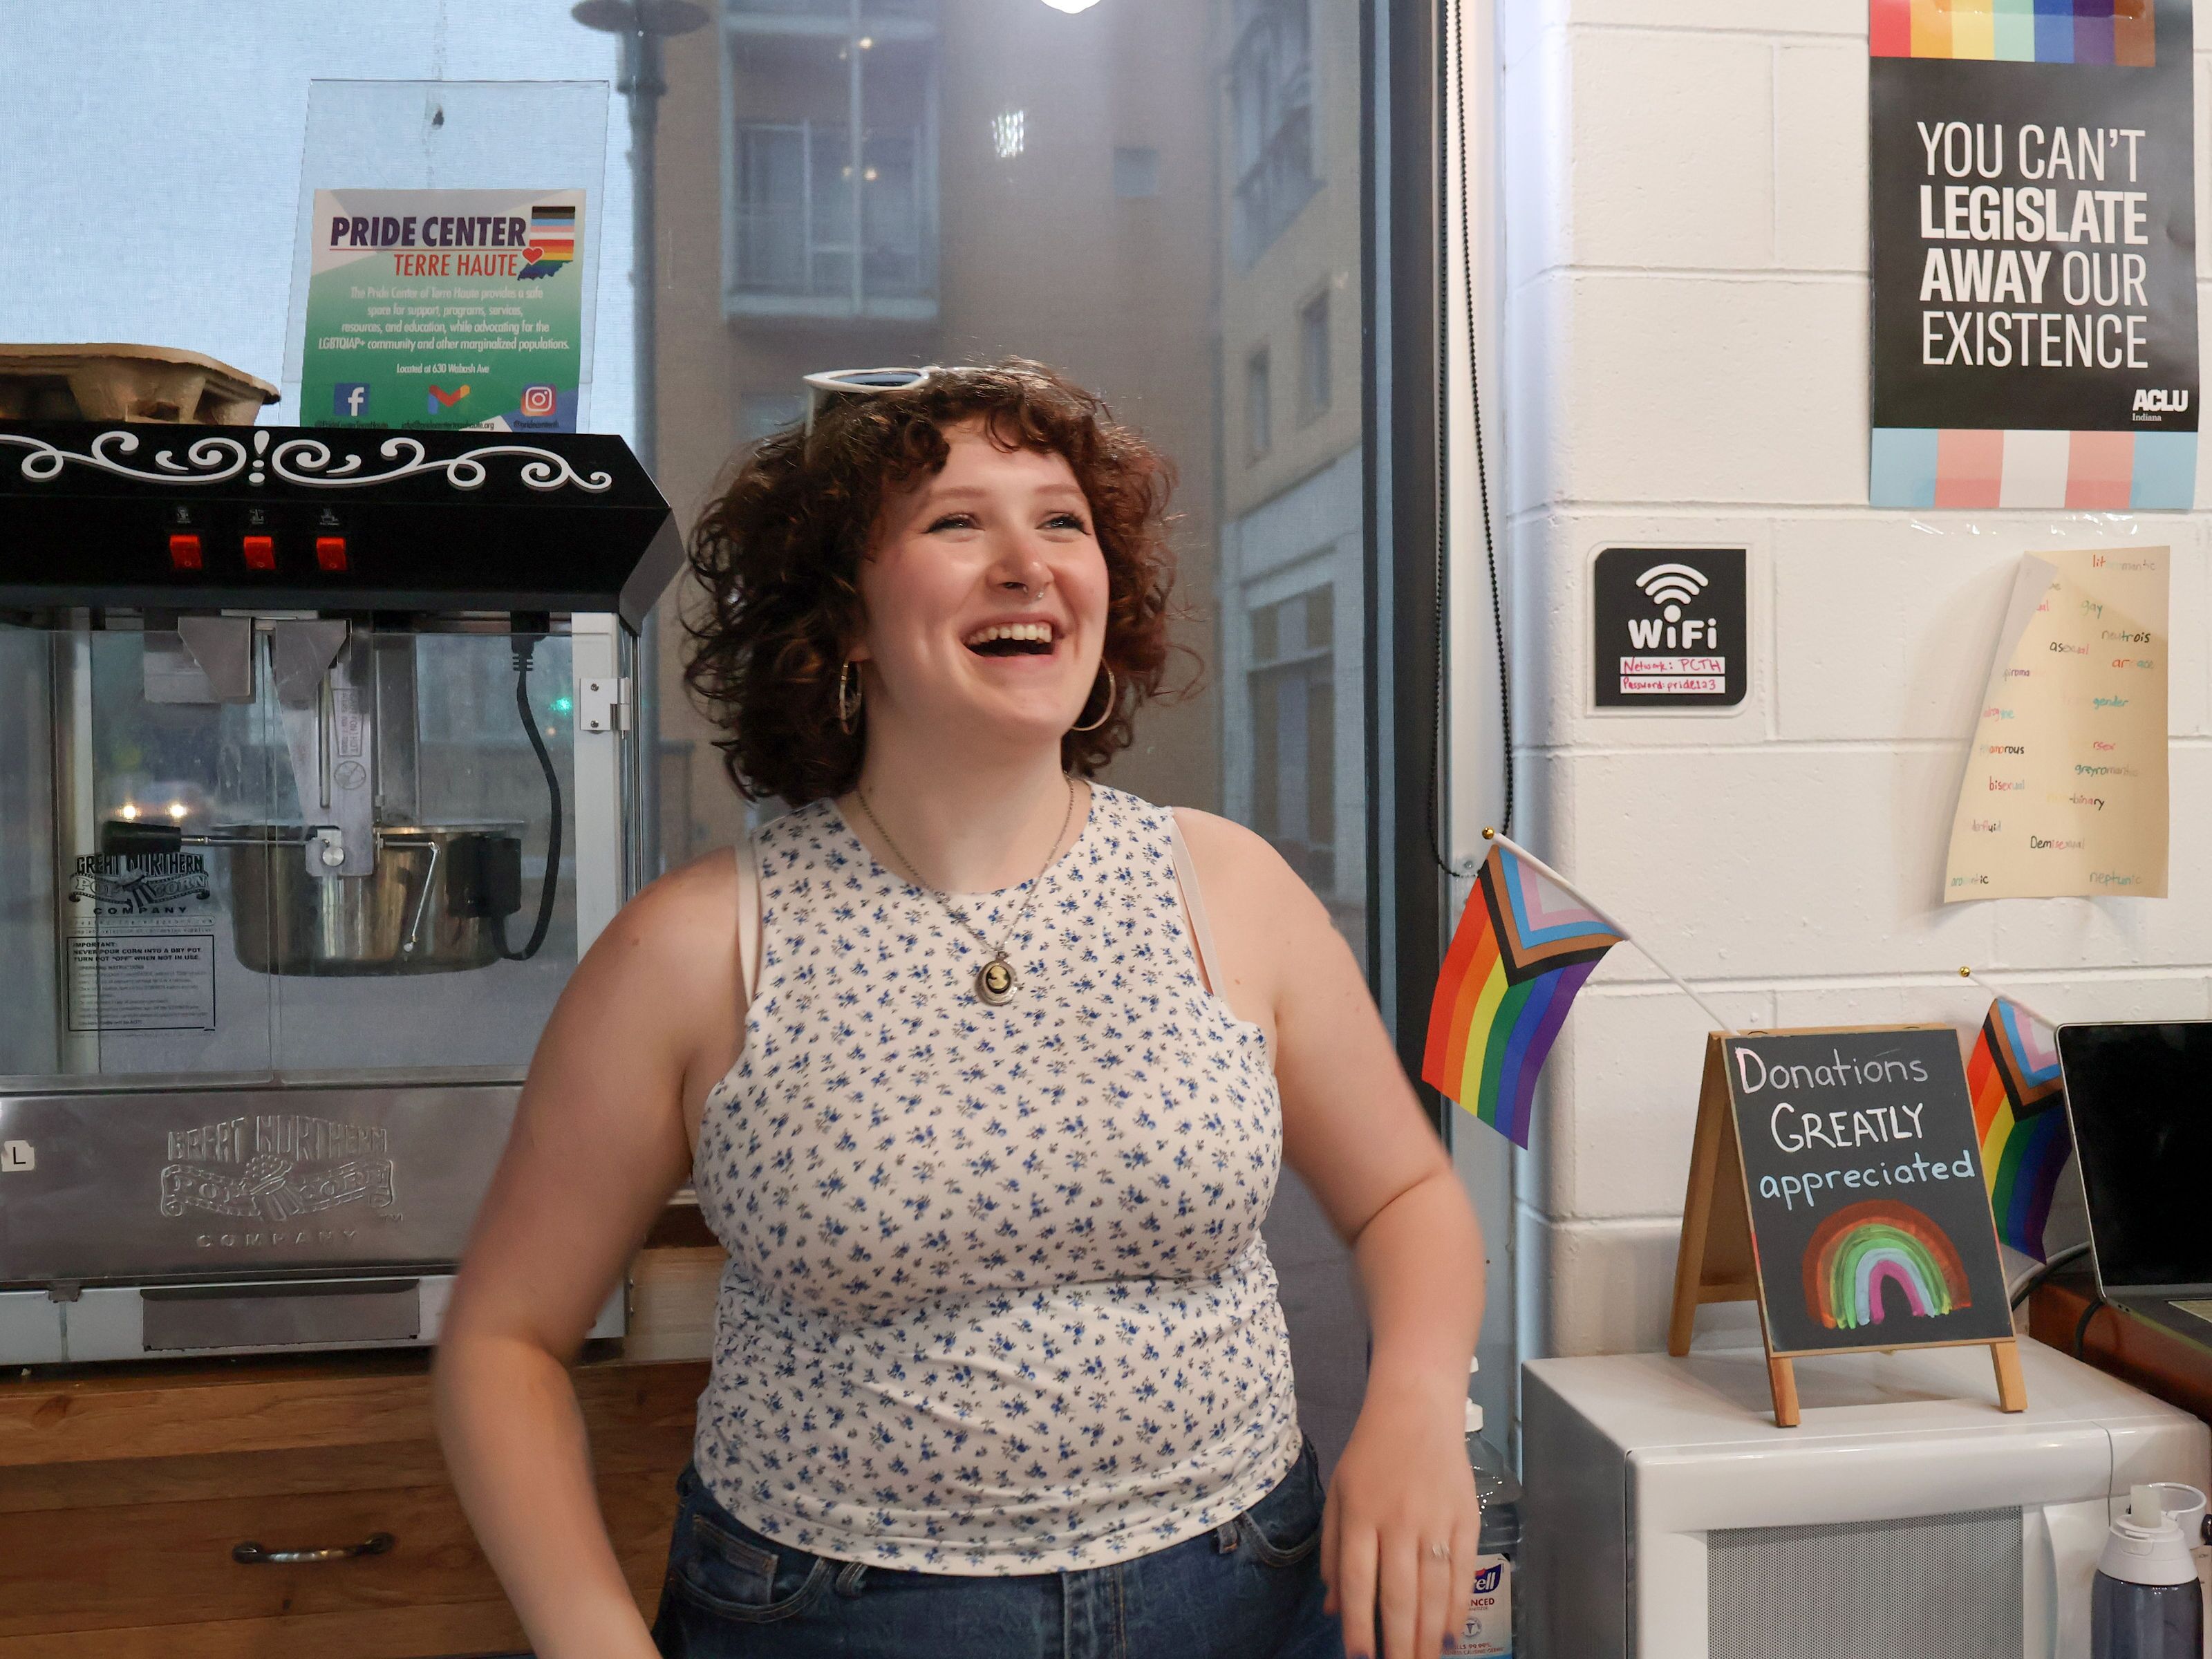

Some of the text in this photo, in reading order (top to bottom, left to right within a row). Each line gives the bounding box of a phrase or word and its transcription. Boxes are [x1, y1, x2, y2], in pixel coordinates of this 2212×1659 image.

[1917, 121, 2146, 182] YOU CAN'T
[1920, 185, 2148, 245] LEGISLATE
[330, 216, 527, 247] PRIDE CENTER
[394, 254, 518, 276] TERRE HAUTE
[1919, 247, 2148, 306] AWAY OUR
[350, 285, 543, 300] The Pride Center of Terre Haute provides a safe
[367, 302, 523, 319] space for support, programs, services,
[341, 319, 550, 335] resources, and education, while advocating for the
[318, 336, 570, 353] LGBTQIAP+ community and other marginalized populations.
[1922, 310, 2148, 369] EXISTENCE
[397, 363, 489, 374] Located at 630 Wabash Ave
[2132, 388, 2188, 413] ACLU
[2132, 413, 2162, 422] Indiana
[2081, 599, 2104, 620] gay
[1627, 617, 1718, 650] WiFi
[2101, 630, 2151, 643] neutrois
[2049, 642, 2090, 655] asexual
[1678, 658, 1722, 673] PCTH
[1988, 775, 2025, 791] bisexual
[2030, 834, 2085, 850] Demisexual
[93, 907, 187, 915] COMPANY
[1735, 1047, 1929, 1094] Donations
[1770, 1102, 1924, 1153] GREATLY
[13, 1146, 26, 1165] L
[1759, 1149, 1976, 1211] appreciated
[1470, 1597, 1494, 1606] NCED
